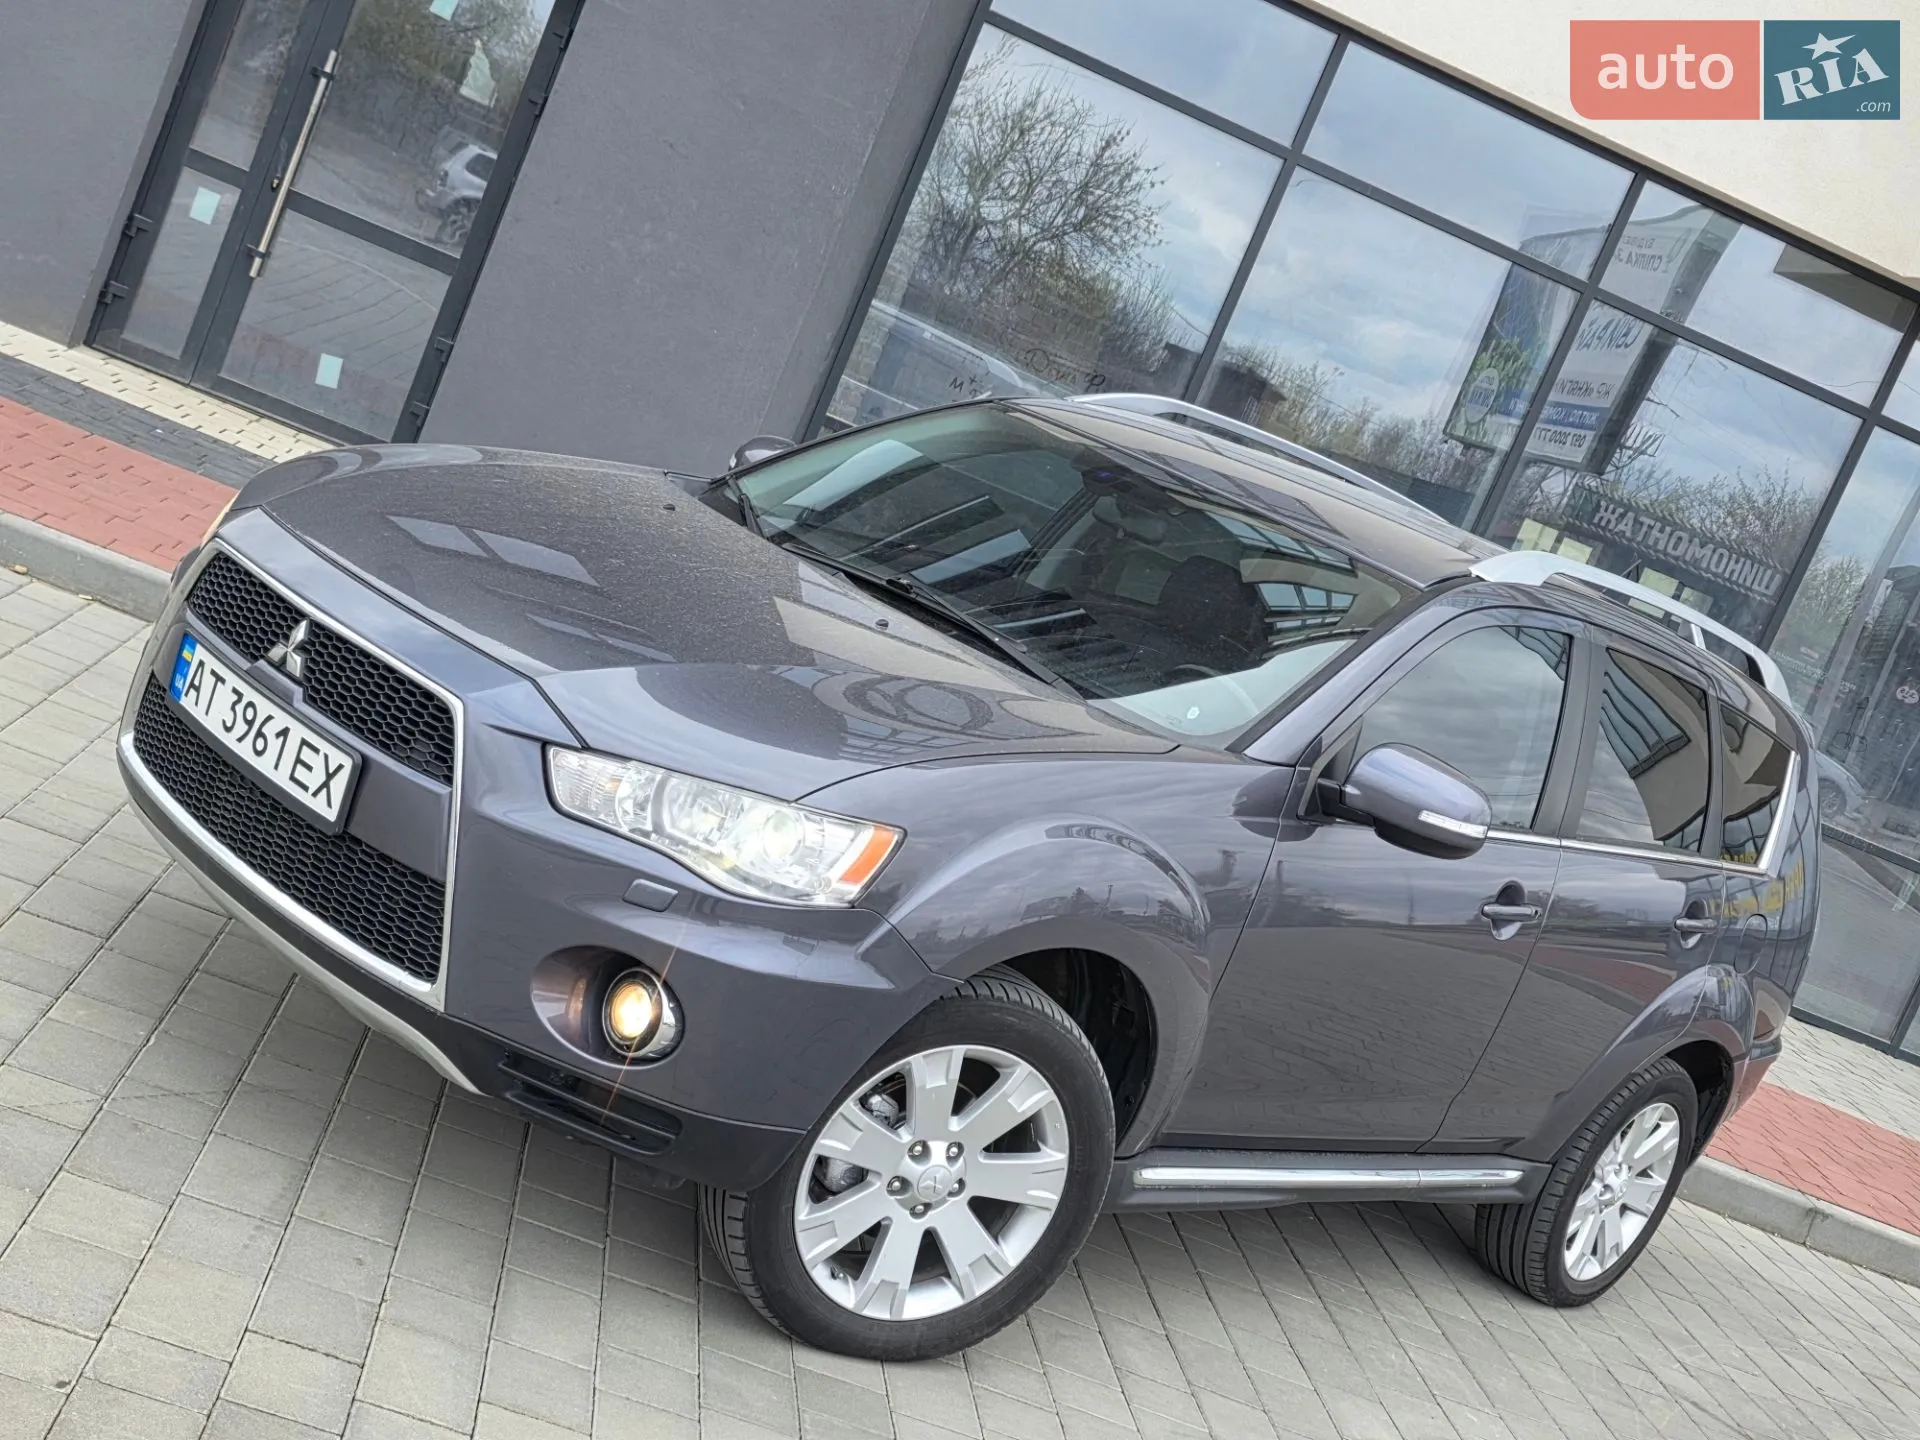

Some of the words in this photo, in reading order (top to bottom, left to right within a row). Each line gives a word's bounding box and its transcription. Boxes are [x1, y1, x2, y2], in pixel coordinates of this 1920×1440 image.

[185, 658, 226, 716] AT
[222, 687, 291, 771] 3961
[289, 737, 346, 809] EX
